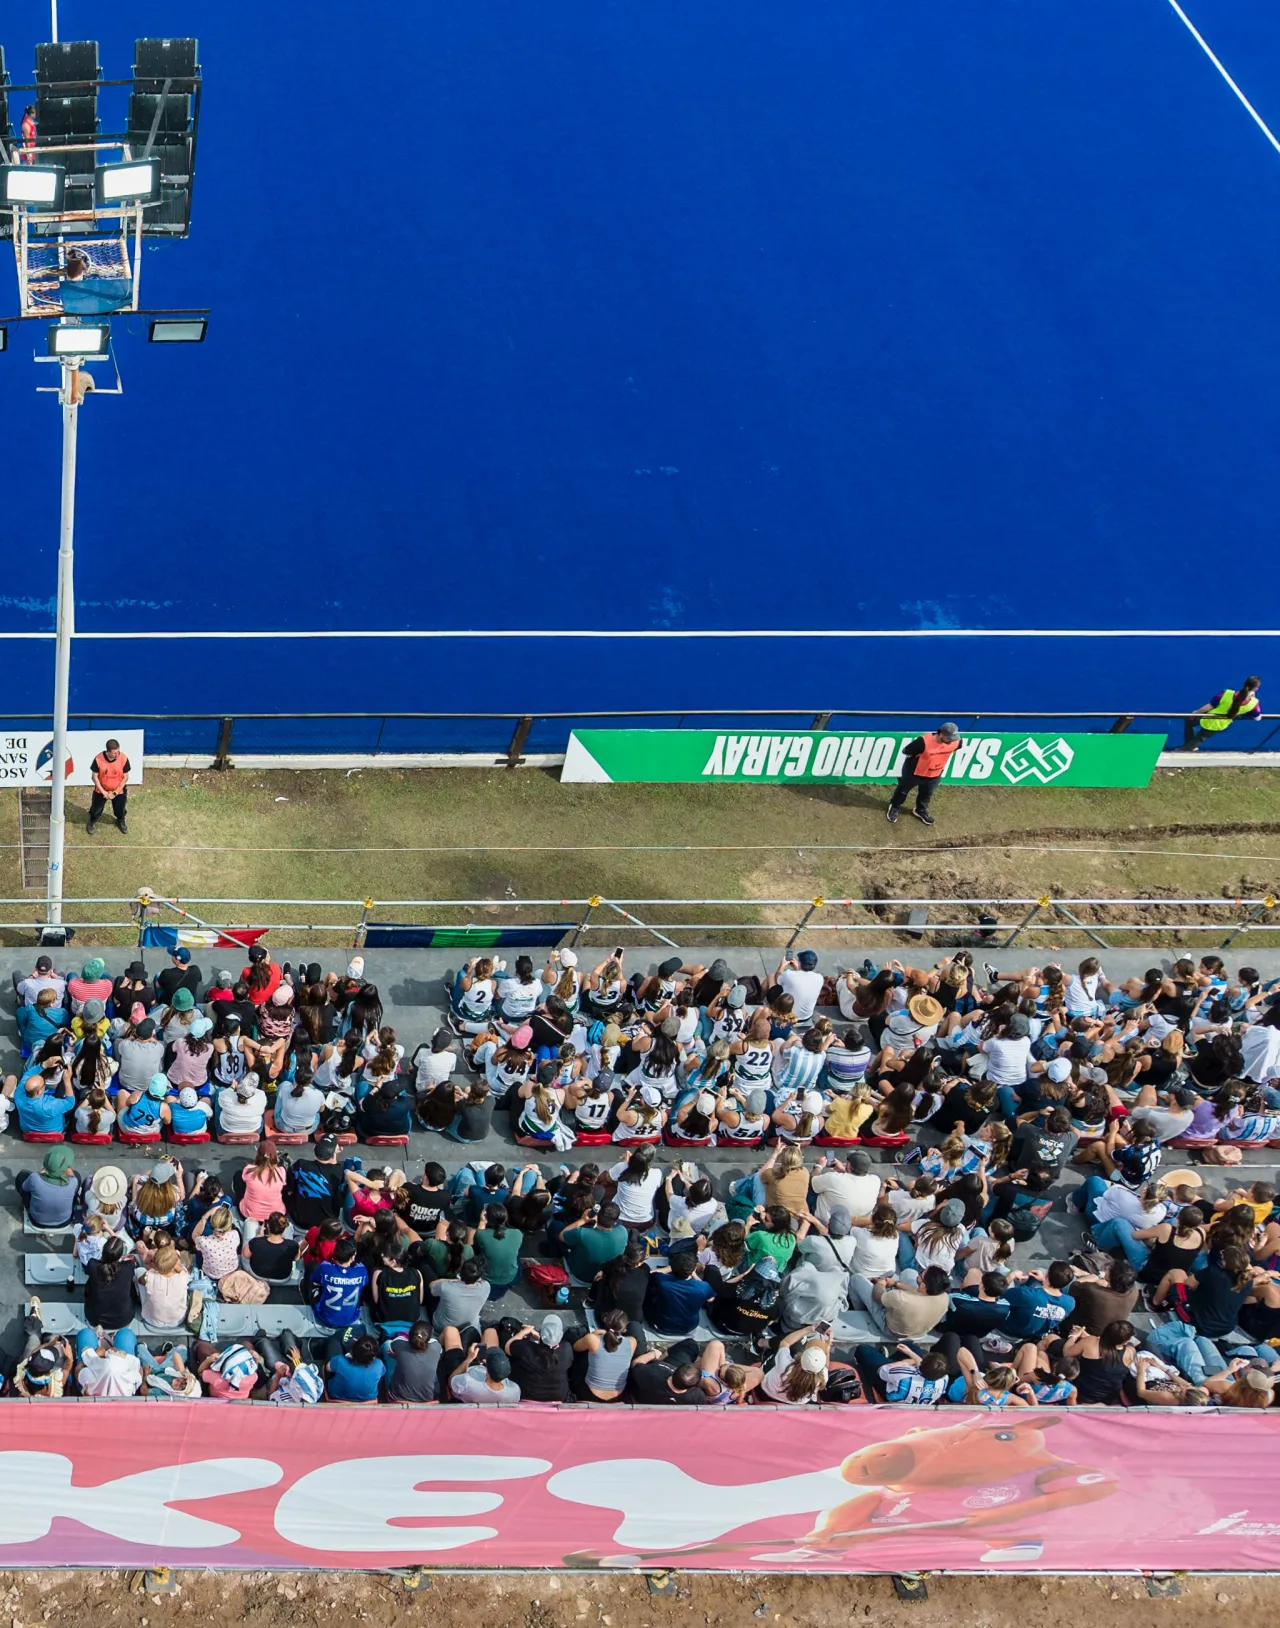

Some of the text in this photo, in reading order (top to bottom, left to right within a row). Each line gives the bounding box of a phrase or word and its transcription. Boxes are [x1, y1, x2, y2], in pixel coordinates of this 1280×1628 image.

[6, 738, 28, 750] DE
[701, 735, 802, 777] GARAY
[812, 736, 1002, 780] SATORIO
[474, 990, 486, 1004] 2
[746, 1051, 770, 1066] 22
[136, 1108, 155, 1127] 79
[587, 1105, 606, 1118] 17
[410, 1203, 441, 1216] QUICK
[325, 1285, 360, 1311] 24
